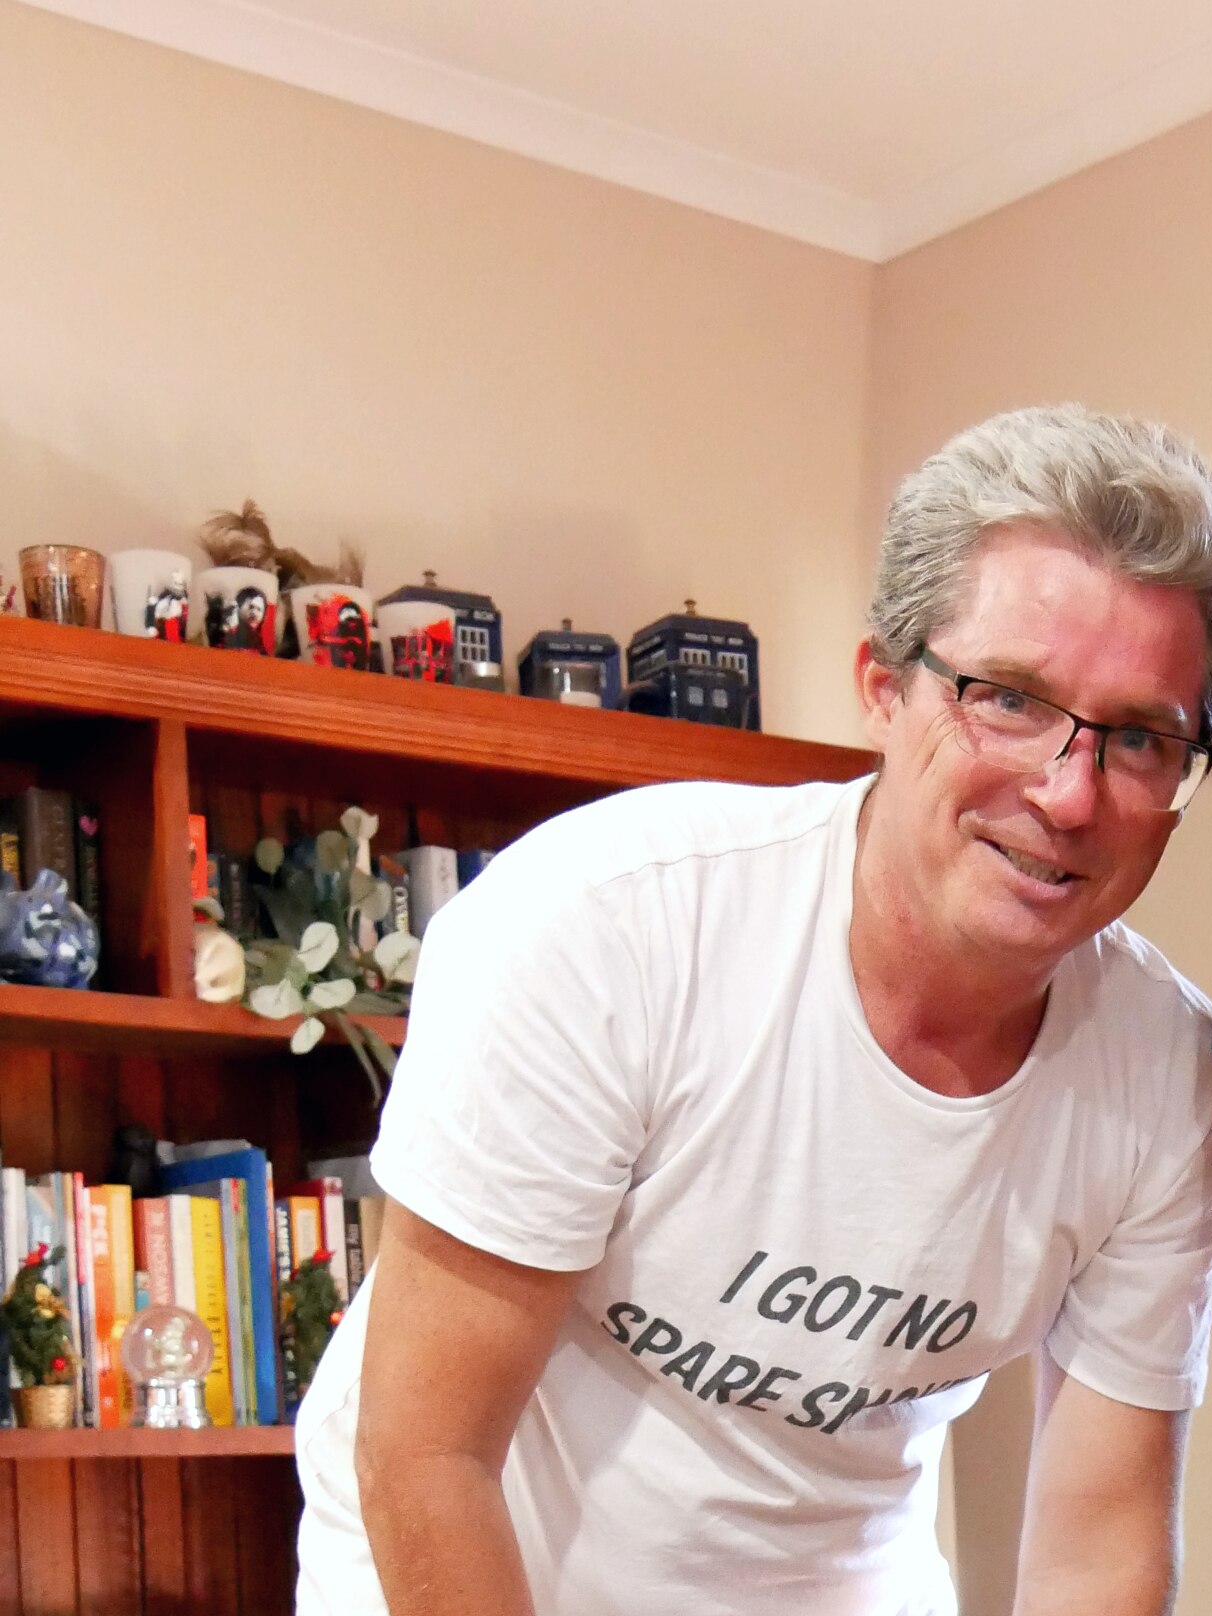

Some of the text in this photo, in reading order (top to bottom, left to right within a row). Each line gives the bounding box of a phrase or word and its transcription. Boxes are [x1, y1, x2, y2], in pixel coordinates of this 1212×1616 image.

[720, 1250, 978, 1354] I GOT NO
[600, 1301, 803, 1412] SPARE
